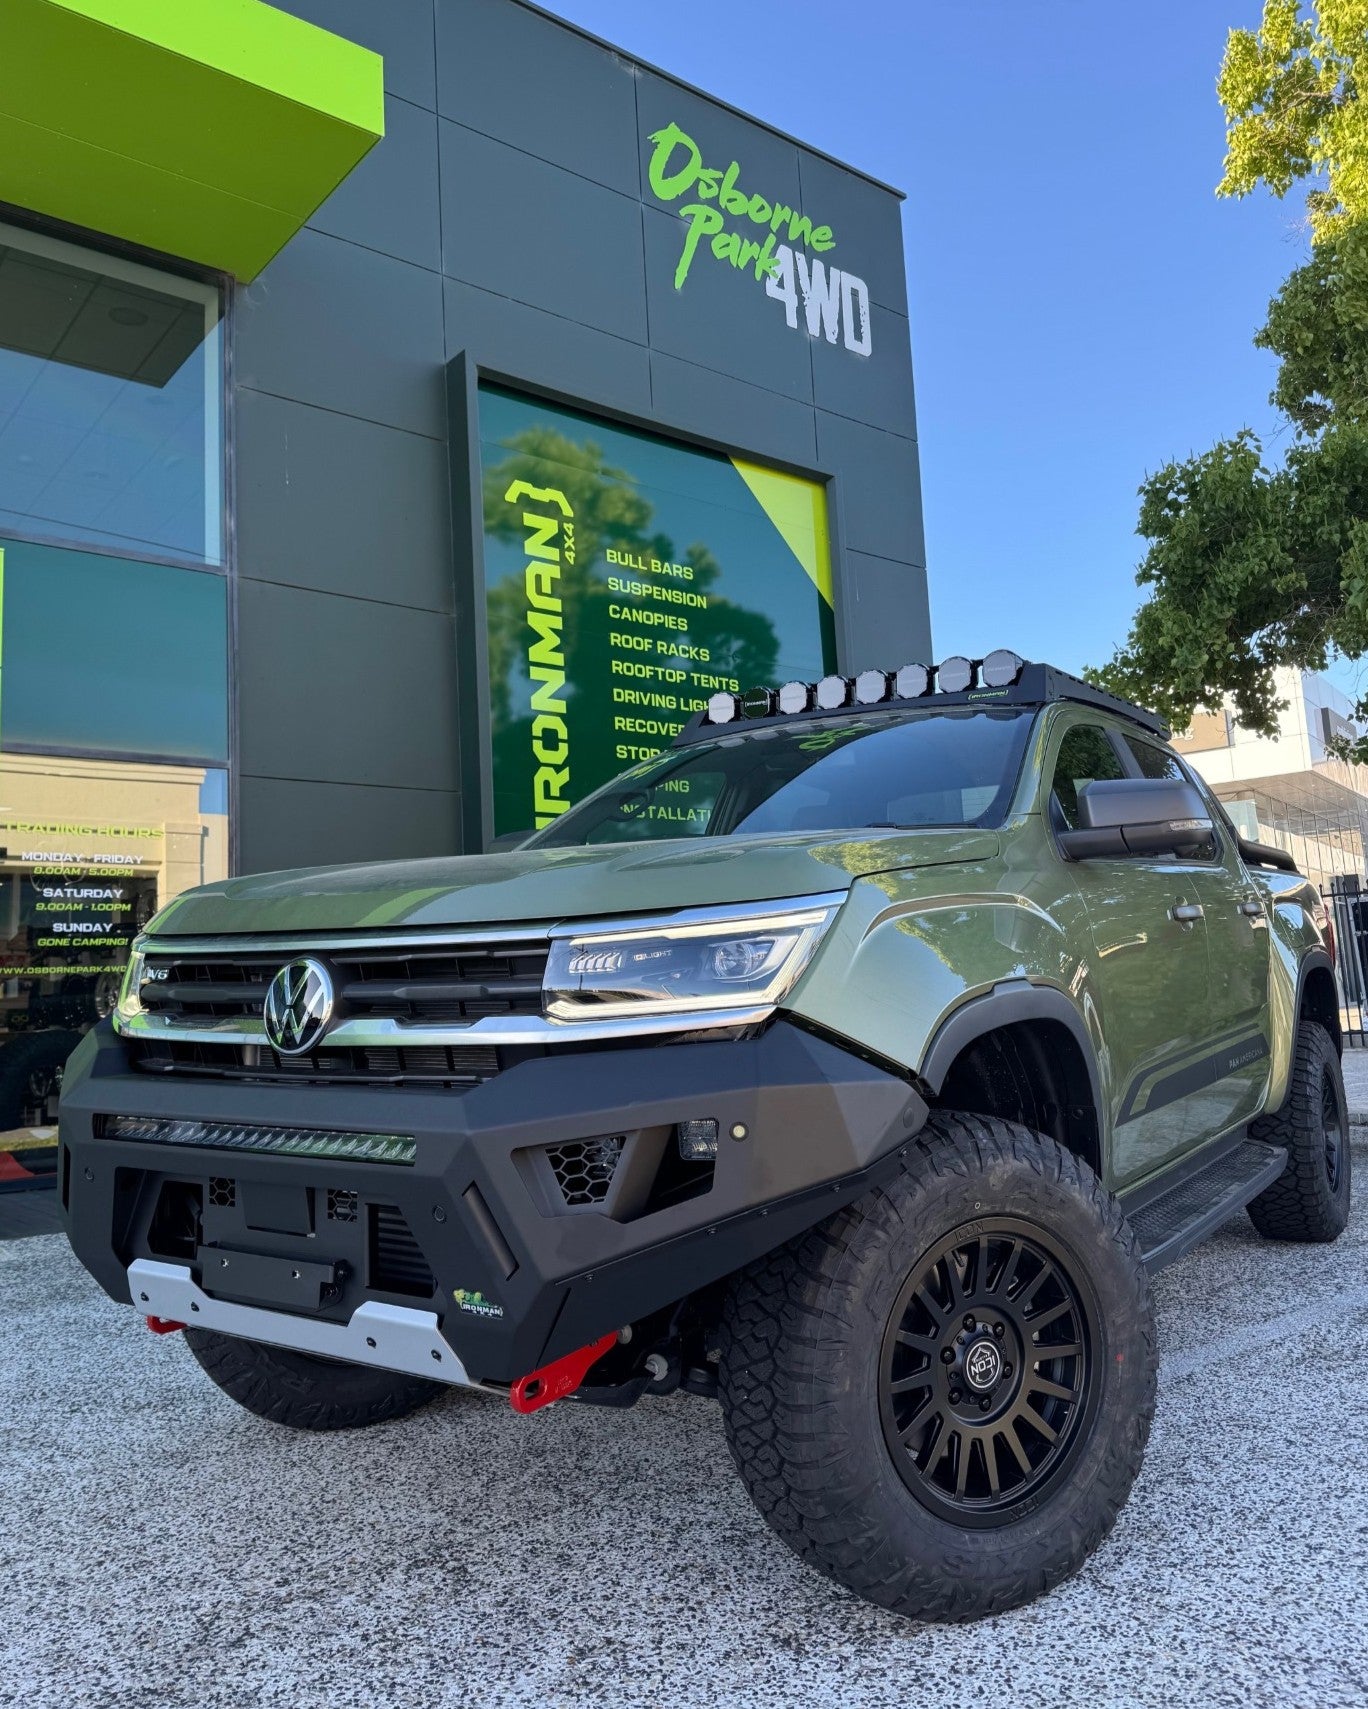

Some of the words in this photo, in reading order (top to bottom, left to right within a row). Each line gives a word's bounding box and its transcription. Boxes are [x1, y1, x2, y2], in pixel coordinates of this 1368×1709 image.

[647, 122, 836, 252] Osborne
[674, 204, 781, 290] Park
[766, 244, 872, 357] 4WD
[564, 522, 576, 566] 4X4
[606, 549, 648, 571] BULL
[651, 559, 694, 580] BARS
[607, 577, 707, 609] SUSPENSION
[609, 604, 688, 631] CANOPIES
[610, 632, 653, 652] ROOF
[657, 641, 710, 662] RACKS
[612, 660, 687, 683] ROOFTOP
[690, 673, 740, 692] TENTS
[613, 688, 677, 709] DRIVING
[4, 821, 93, 837] TRADING
[98, 825, 164, 839] HOURS
[21, 851, 83, 863] MONDAY
[94, 854, 144, 864] FRIDAY
[88, 867, 134, 877] 5.00PM
[43, 887, 124, 899] SATURDAY
[35, 903, 83, 912] 9.00AM
[91, 903, 132, 912] 1.00PM
[52, 923, 113, 933] SUNDAY
[37, 938, 71, 947] GONE
[72, 938, 129, 947] CAMPING!
[0, 965, 127, 975] WW.OSBORNEPARK4WD
[971, 1355, 996, 1376] ICON
